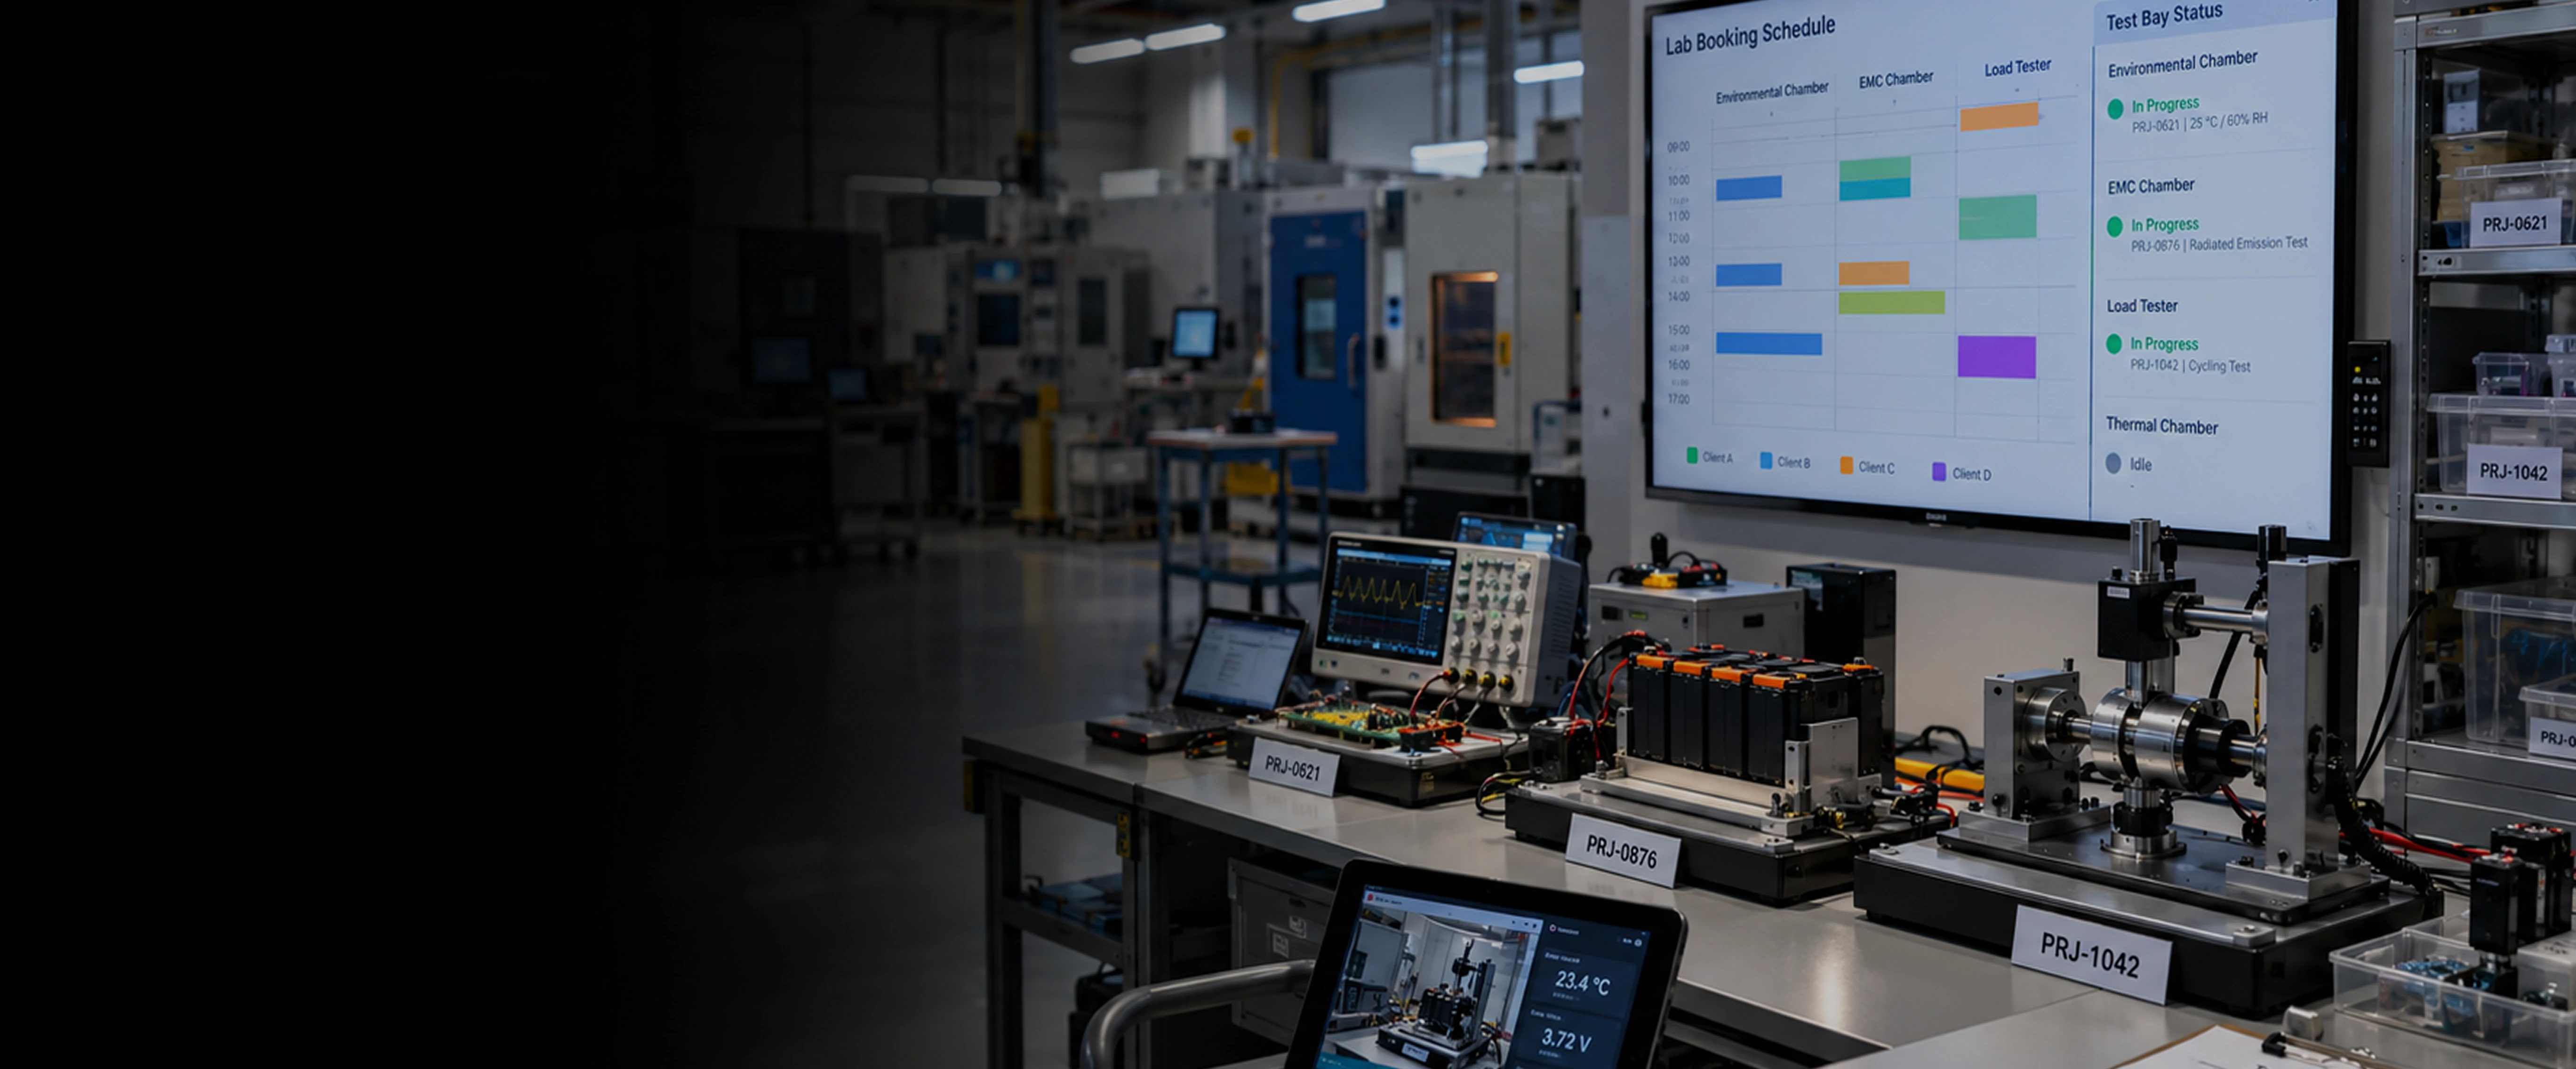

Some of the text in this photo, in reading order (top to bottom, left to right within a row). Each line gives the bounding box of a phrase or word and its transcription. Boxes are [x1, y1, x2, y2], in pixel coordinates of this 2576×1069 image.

[2107, 3, 2223, 31] Test Bay Status
[1666, 15, 1835, 55] Lab Booking Schedule
[1985, 57, 2052, 77] Load Tester
[2108, 50, 2258, 78] Environmental Chamber
[1859, 69, 1934, 89] EMC Chamber
[1716, 80, 1829, 105] Environmental Chamber
[2132, 97, 2200, 113] In Progress
[2132, 120, 2179, 133] PRJ-0621
[2190, 117, 2203, 129] 25
[2206, 115, 2217, 128] °C
[2220, 115, 2225, 128] /
[2227, 114, 2249, 127] 60%
[2253, 112, 2268, 124] RH
[2108, 178, 2195, 194] EMC Chamber
[2132, 218, 2200, 234] In Progress
[2483, 215, 2547, 232] PRJ-0621
[2190, 239, 2234, 250] Radiated
[2237, 237, 2283, 250] Emission
[2287, 235, 2308, 248] Test
[2108, 299, 2178, 313] Load Tester
[2131, 337, 2199, 353] In Progress
[2131, 359, 2178, 372] PRJ-1042
[2189, 359, 2226, 374] Cycling
[2229, 359, 2251, 373] Test
[2106, 416, 2218, 435] Thermal Chamber
[1703, 451, 1734, 463] Client A
[1778, 456, 1811, 469] Client B
[2131, 457, 2152, 471] Idle
[1859, 461, 1895, 474] Client C
[1953, 467, 1992, 481] Client D
[2480, 463, 2548, 481] PRJ-1042
[1265, 754, 1321, 781] PRJ-0621
[1587, 834, 1657, 870] PRJ-0876
[2040, 932, 2140, 979] PRJ-1042
[1555, 970, 1610, 996] 23.4 °C
[1542, 1027, 1592, 1053] 3.72 V
